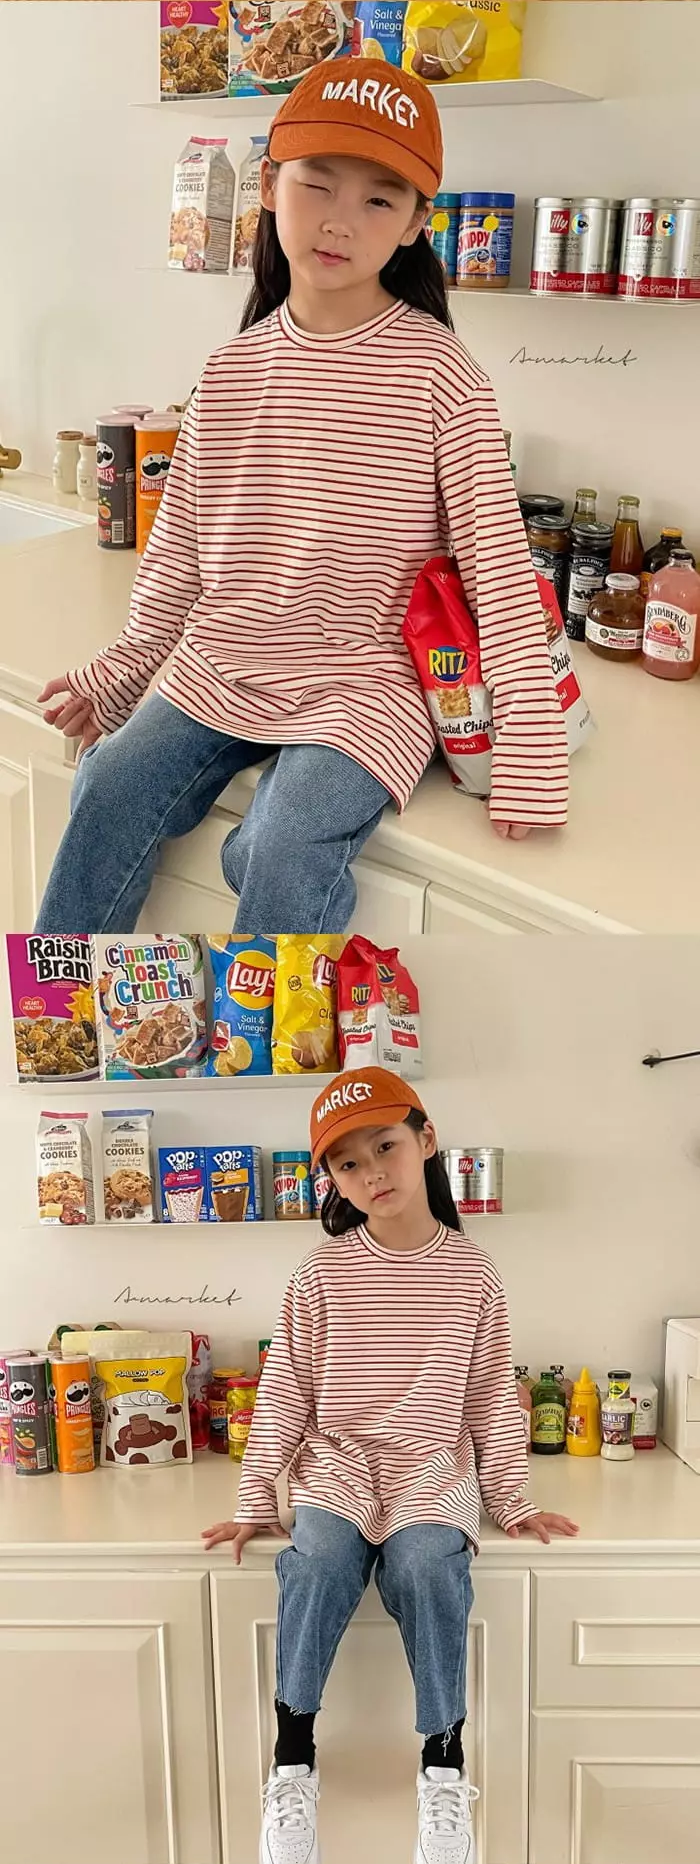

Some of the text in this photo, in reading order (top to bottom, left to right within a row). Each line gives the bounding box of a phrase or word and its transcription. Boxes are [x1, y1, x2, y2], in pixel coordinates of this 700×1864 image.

[169, 11, 189, 19] HEALTHY
[374, 9, 403, 20] Salt &
[369, 19, 402, 33] Vinega
[321, 78, 420, 129] MARKET
[175, 182, 205, 192] COOKIES
[550, 214, 568, 232] illy
[634, 213, 652, 234] illy
[458, 230, 490, 253] IPPY
[428, 649, 466, 676] RITZ
[463, 719, 494, 734] Chips
[453, 742, 477, 750] original
[28, 937, 91, 962] Raisin
[107, 942, 190, 965] Cinnamon
[37, 960, 92, 982] Bran
[126, 960, 177, 982] Toast
[117, 973, 193, 1004] Crunch
[240, 1015, 265, 1024] Salt &
[237, 1022, 268, 1034] Vinegar
[316, 1082, 373, 1123] MARKET
[40, 1150, 78, 1160] COOKIES
[105, 1147, 145, 1156] COOKIES
[459, 1159, 473, 1173] illy
[115, 1368, 166, 1378] MALLOW POP
